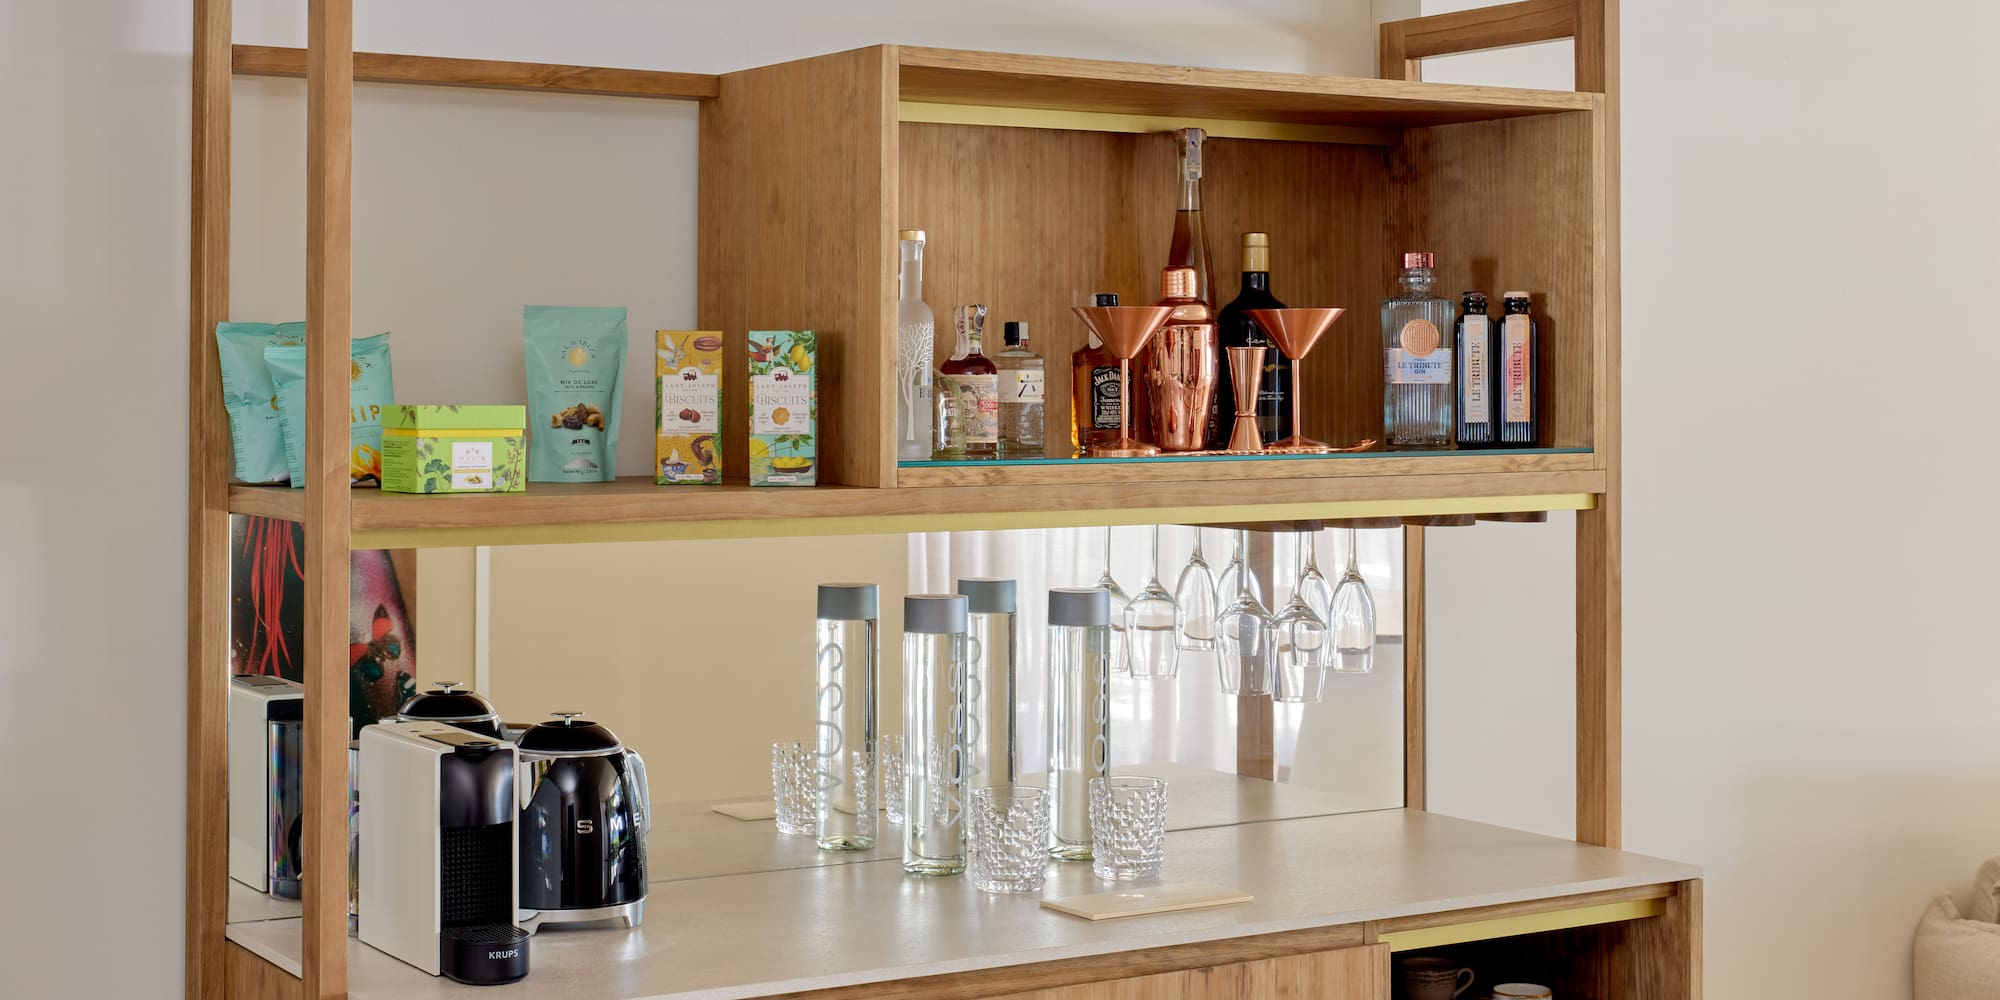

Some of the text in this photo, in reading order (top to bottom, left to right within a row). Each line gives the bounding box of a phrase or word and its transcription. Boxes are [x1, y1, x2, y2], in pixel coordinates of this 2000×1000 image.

[1397, 361, 1408, 369] LE
[1409, 361, 1444, 369] TRIBUTE
[1471, 342, 1481, 402] LE TRIBUTE
[1512, 342, 1522, 402] LE TRIBUTE
[1094, 373, 1109, 386] JACK
[664, 393, 716, 405] BISCUITS
[756, 394, 808, 406] BISCUITS
[946, 656, 963, 827] VOSS
[488, 949, 519, 960] KRUPS
